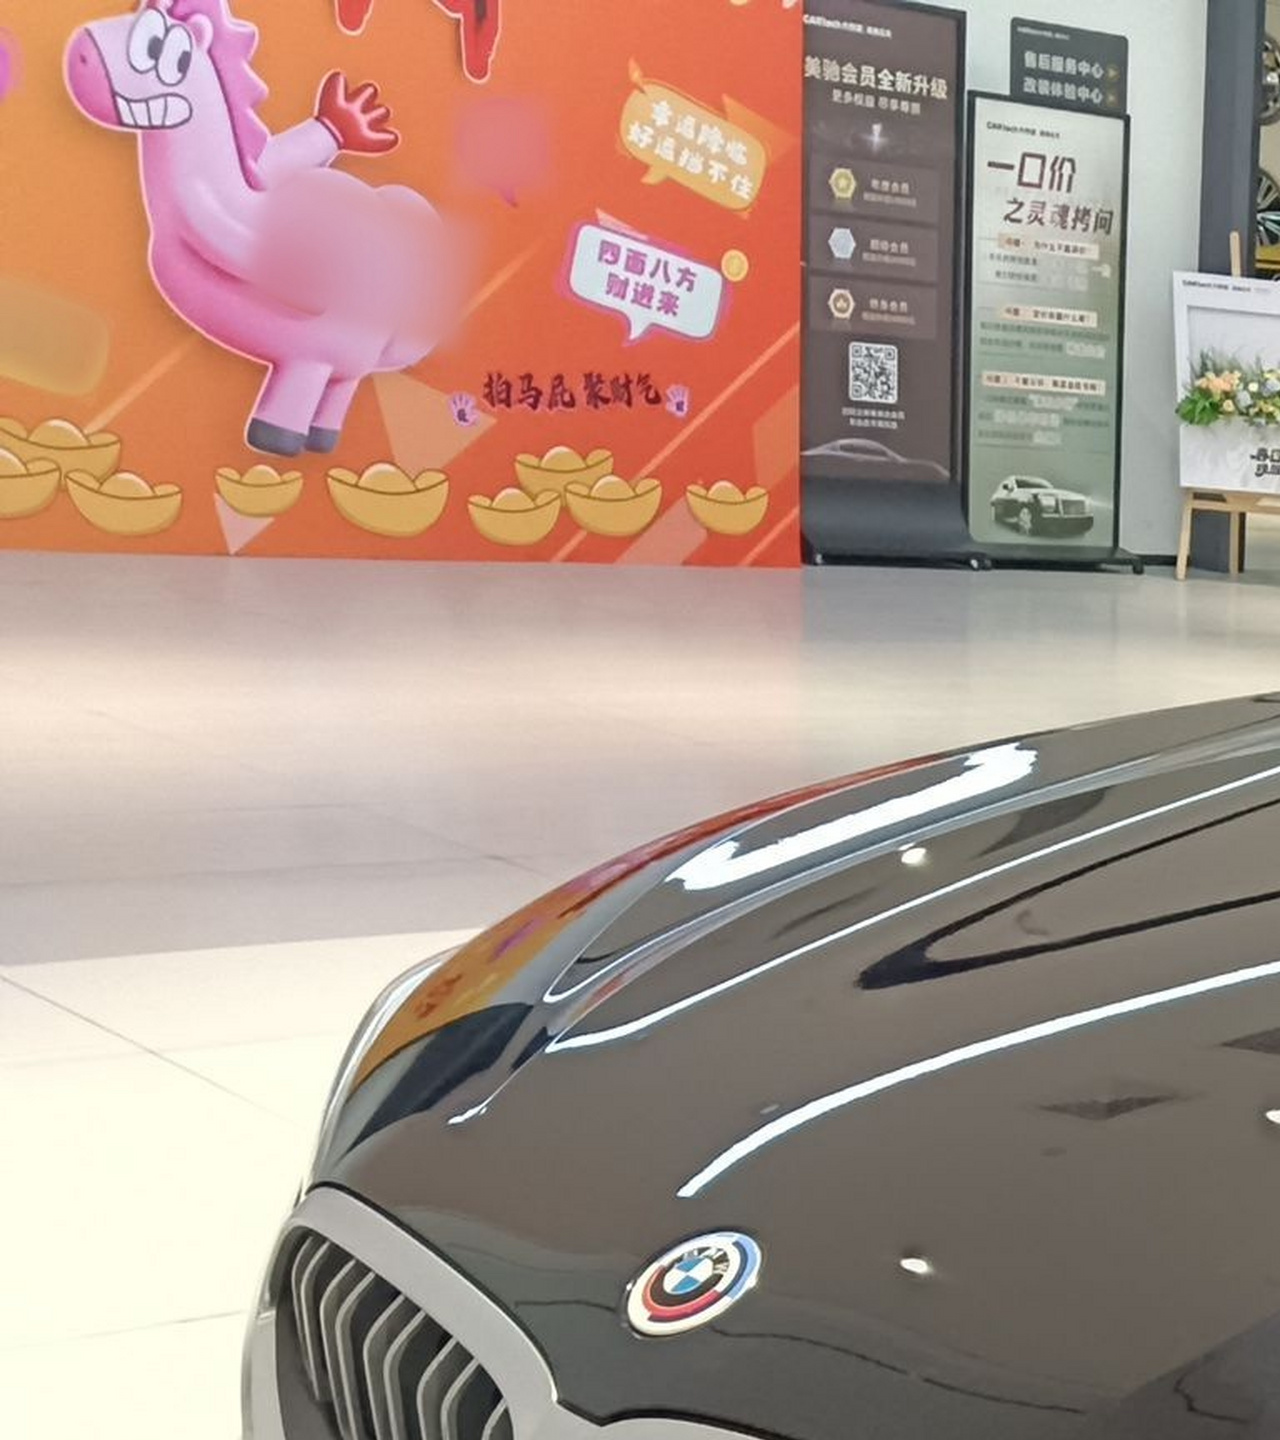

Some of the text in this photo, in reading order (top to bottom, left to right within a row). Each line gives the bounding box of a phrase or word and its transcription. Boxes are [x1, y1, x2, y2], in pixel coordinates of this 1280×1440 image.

[804, 55, 948, 100] 美驰会员全新升级
[1024, 50, 1104, 79] 售后服务中心
[1023, 76, 1103, 104] 改装体验中心
[987, 152, 1076, 193] 一口价
[1003, 198, 1113, 236] 之灵魂拷问
[598, 239, 697, 292] 四面八方
